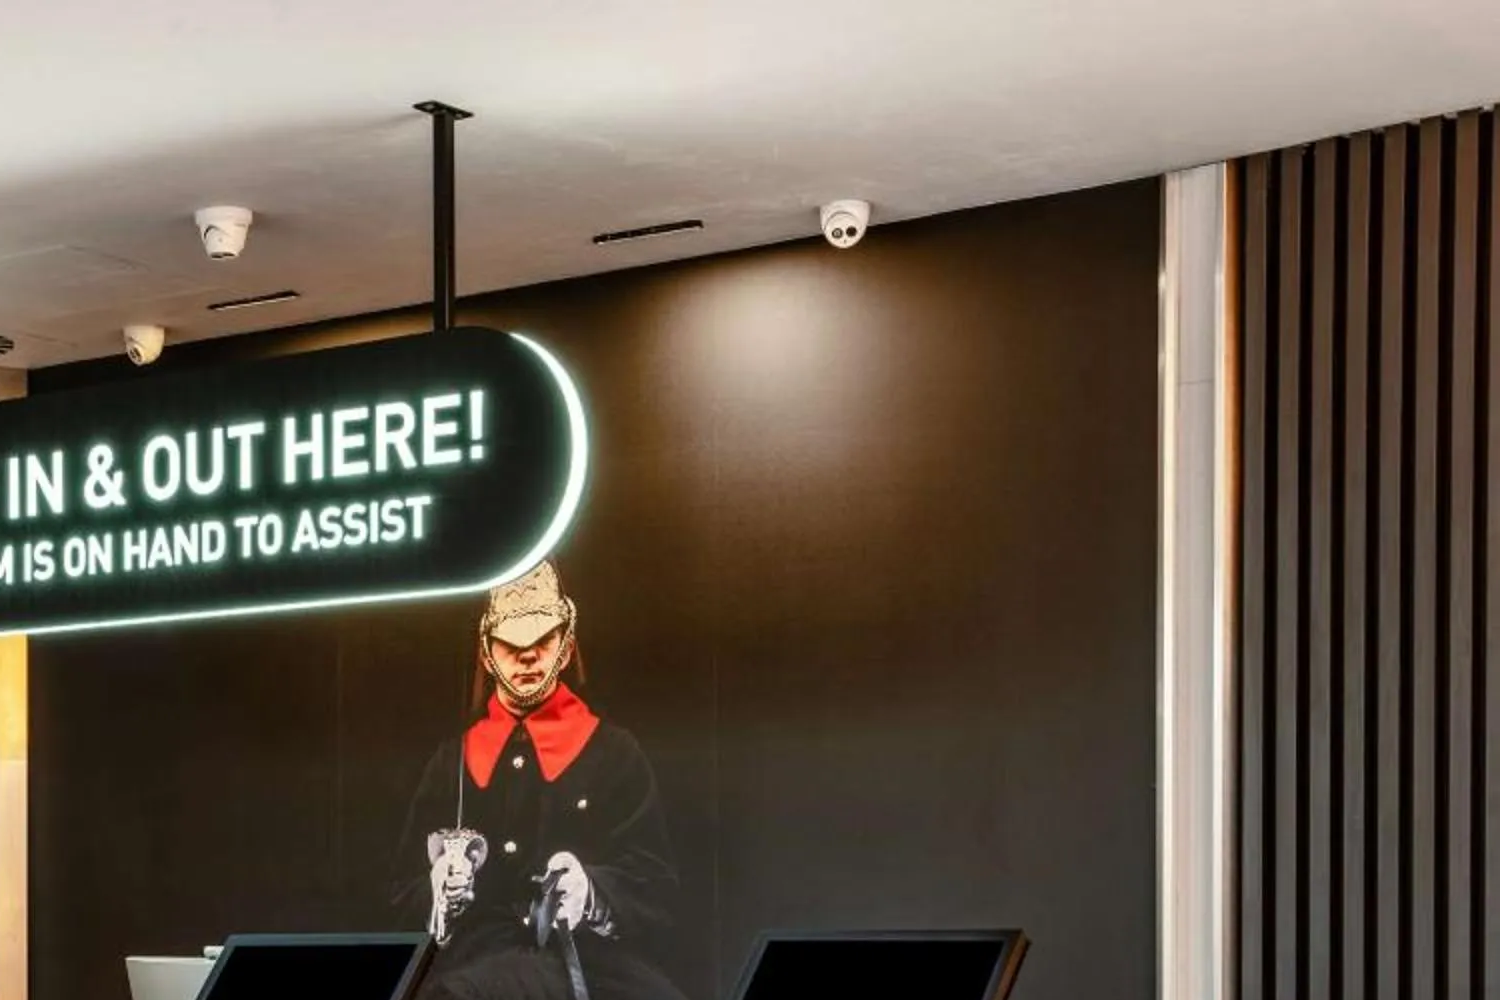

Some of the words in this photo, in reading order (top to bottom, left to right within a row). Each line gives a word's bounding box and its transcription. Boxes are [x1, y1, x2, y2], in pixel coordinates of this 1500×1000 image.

[7, 449, 65, 520] IN
[83, 443, 127, 510] &
[141, 420, 266, 502] OUT
[282, 389, 485, 485] HERE!
[22, 539, 56, 583] IS
[62, 532, 114, 578] ON
[122, 520, 227, 572] HAND
[233, 512, 284, 559] TO
[290, 494, 433, 553] ASSIST
